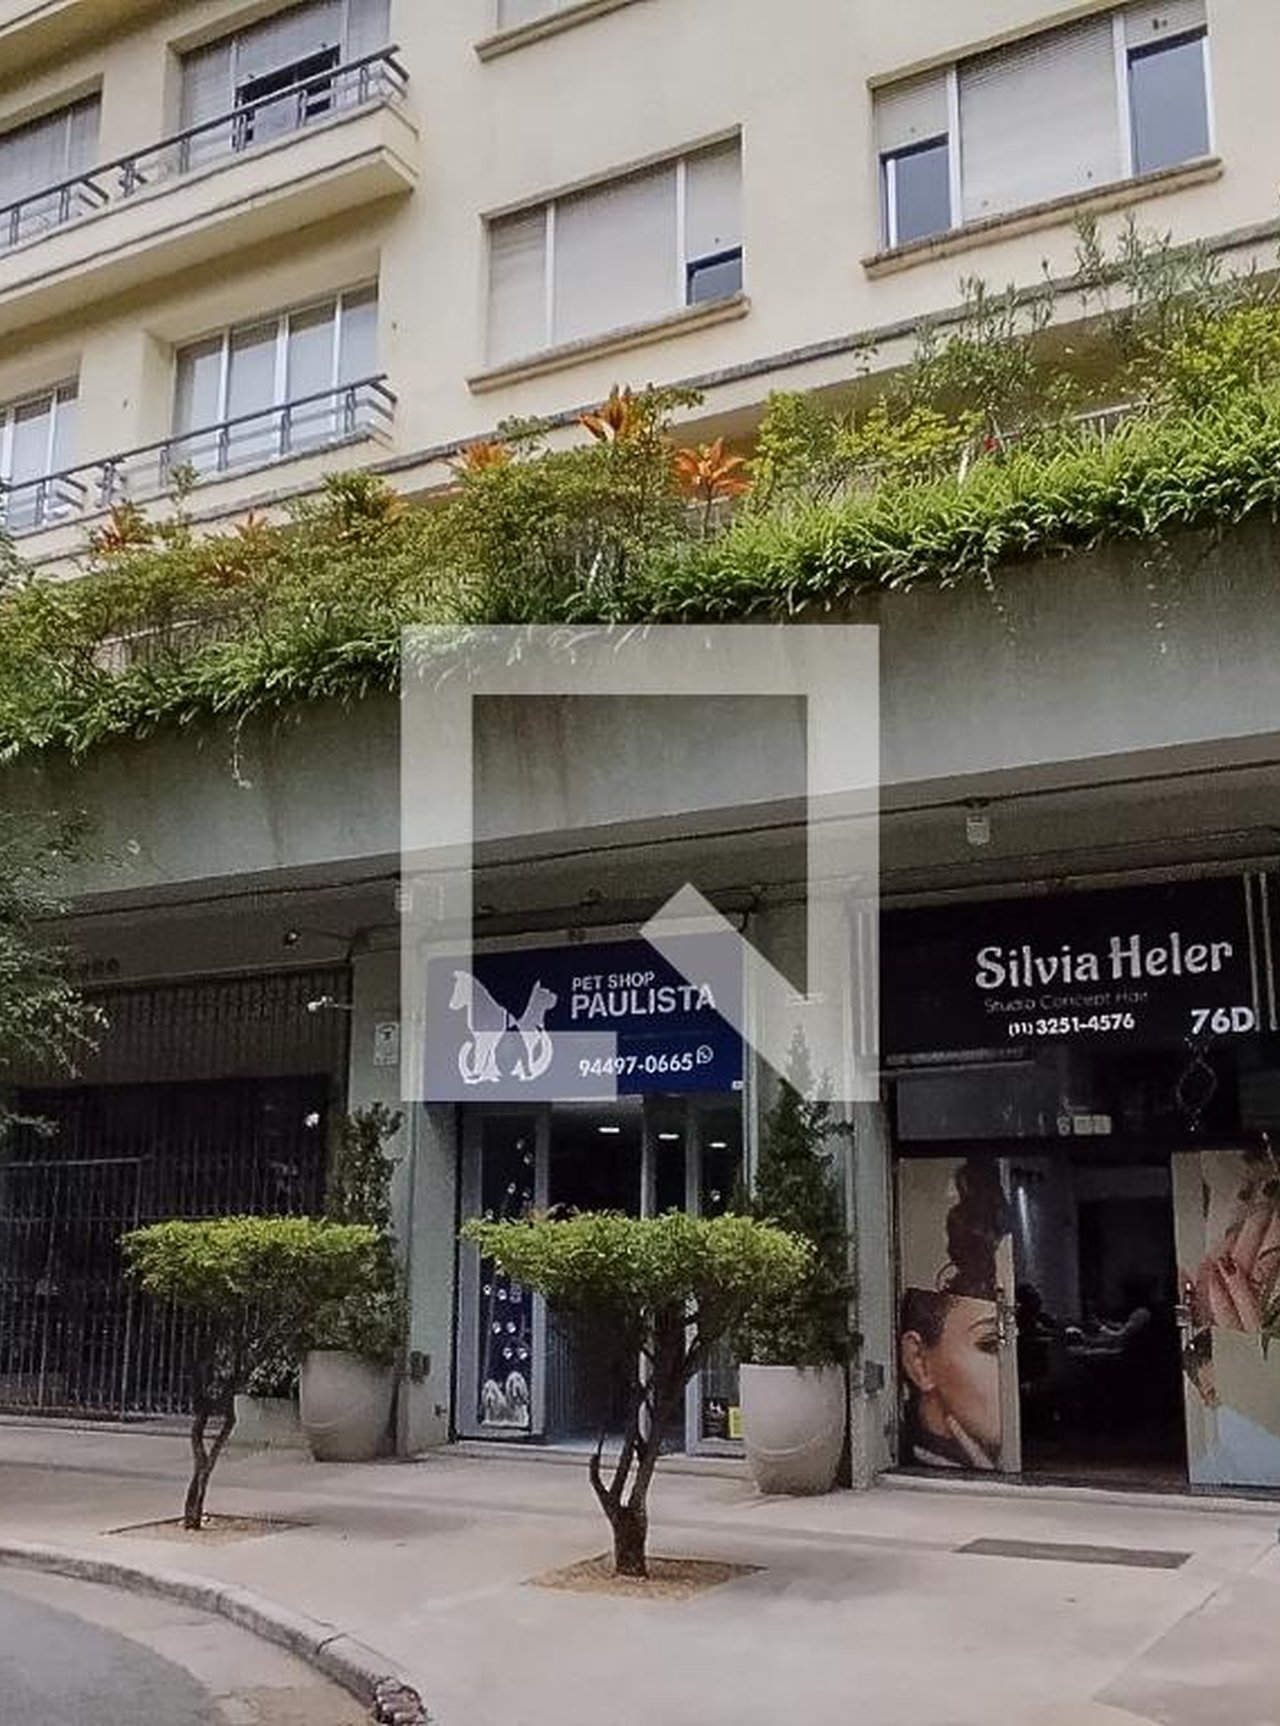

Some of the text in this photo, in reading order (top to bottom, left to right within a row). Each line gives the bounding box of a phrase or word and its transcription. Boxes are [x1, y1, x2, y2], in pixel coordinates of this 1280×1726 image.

[975, 931, 1233, 989] Silvia Heler
[572, 970, 655, 991] PET SHOP
[571, 983, 717, 1020] PAULISTA
[1008, 1013, 1135, 1037] (11) 3251-4576
[1190, 1006, 1255, 1035] 76D
[579, 1052, 694, 1077] 94497-0665
